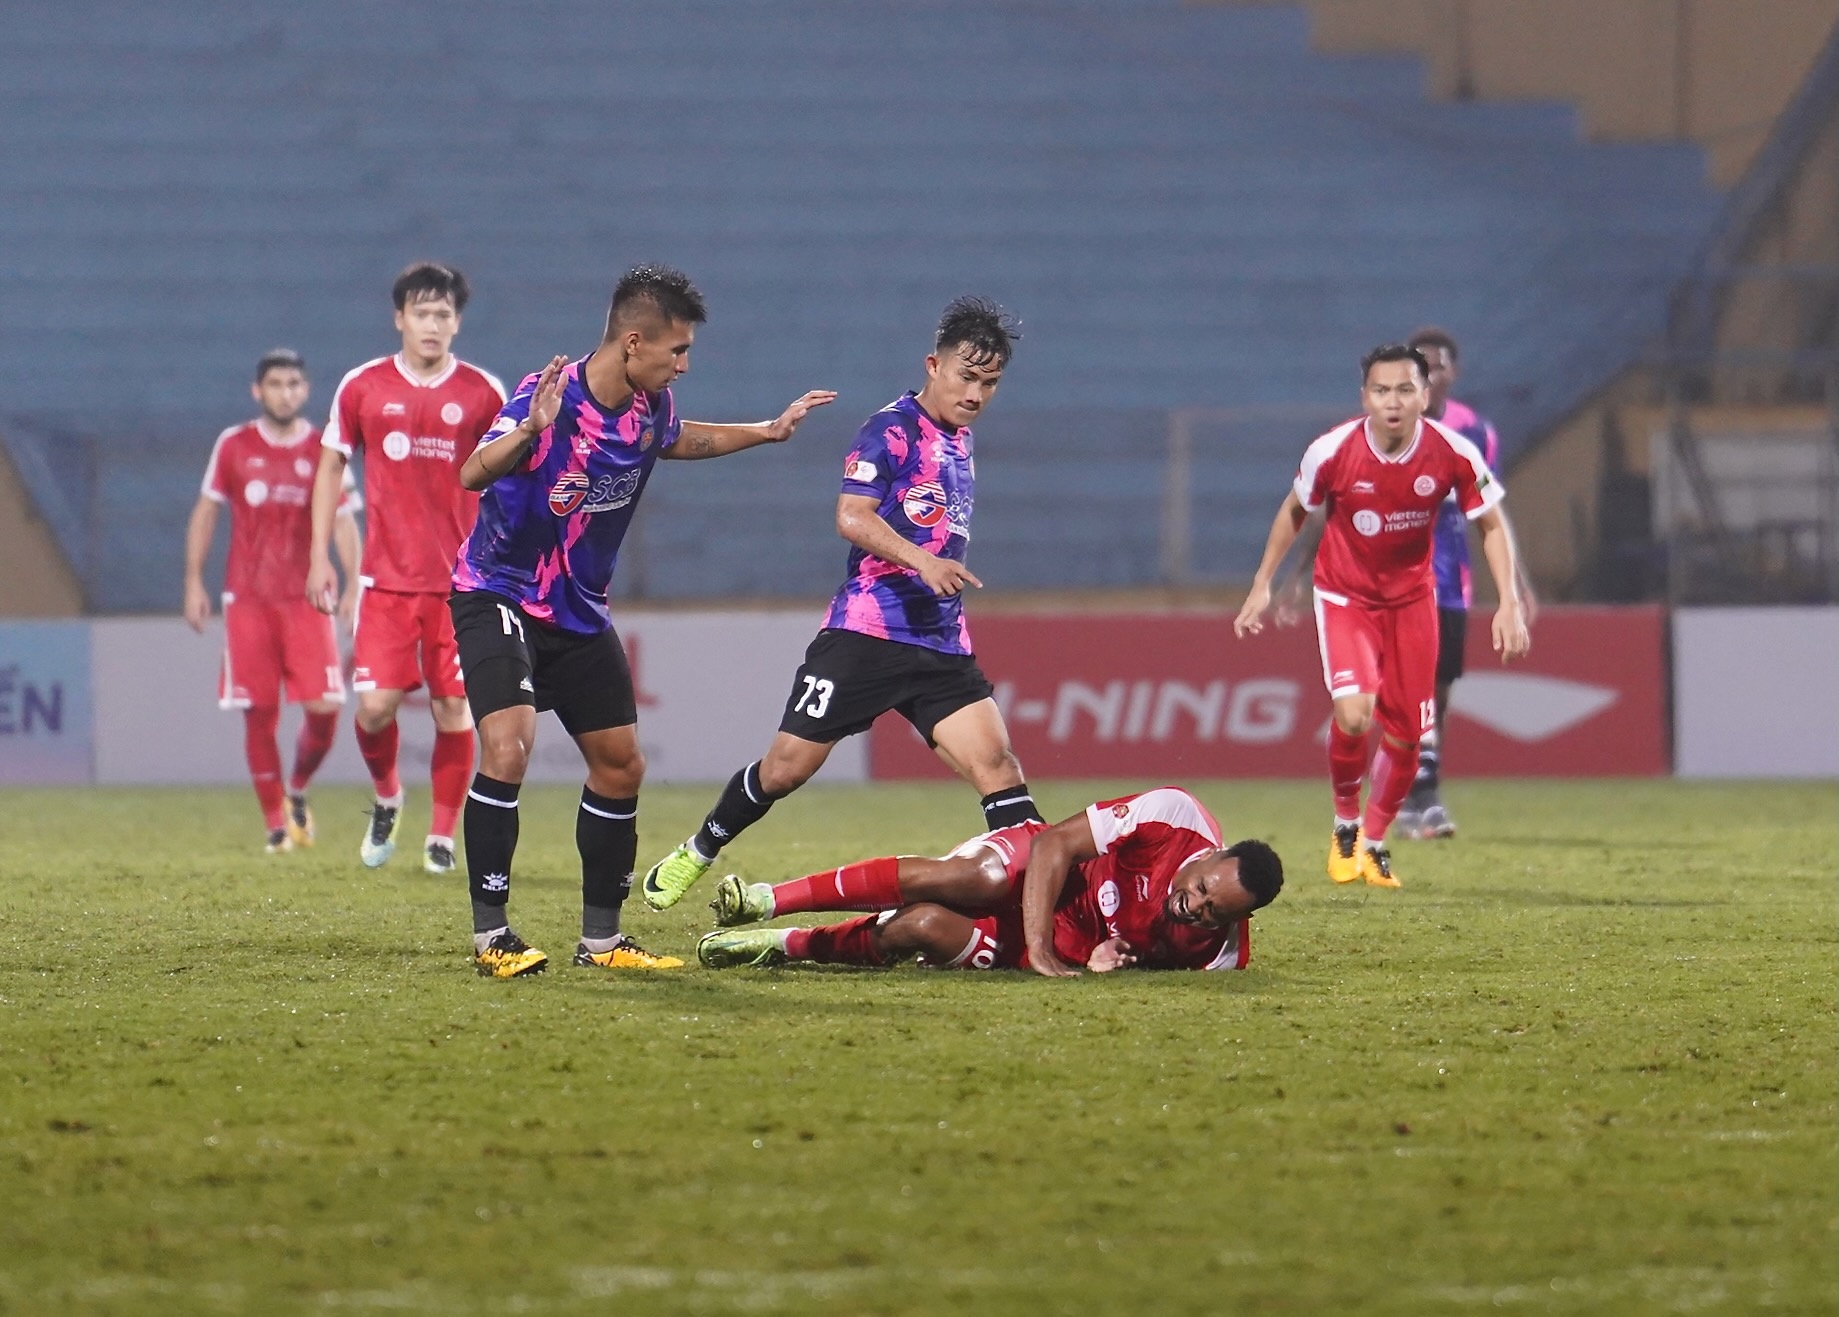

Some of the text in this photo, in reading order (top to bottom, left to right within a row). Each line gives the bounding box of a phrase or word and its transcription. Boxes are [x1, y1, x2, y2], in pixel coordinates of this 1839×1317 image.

[412, 436, 455, 451] viettel
[411, 446, 455, 463] money
[1384, 510, 1431, 523] viettel
[794, 675, 834, 719] 73
